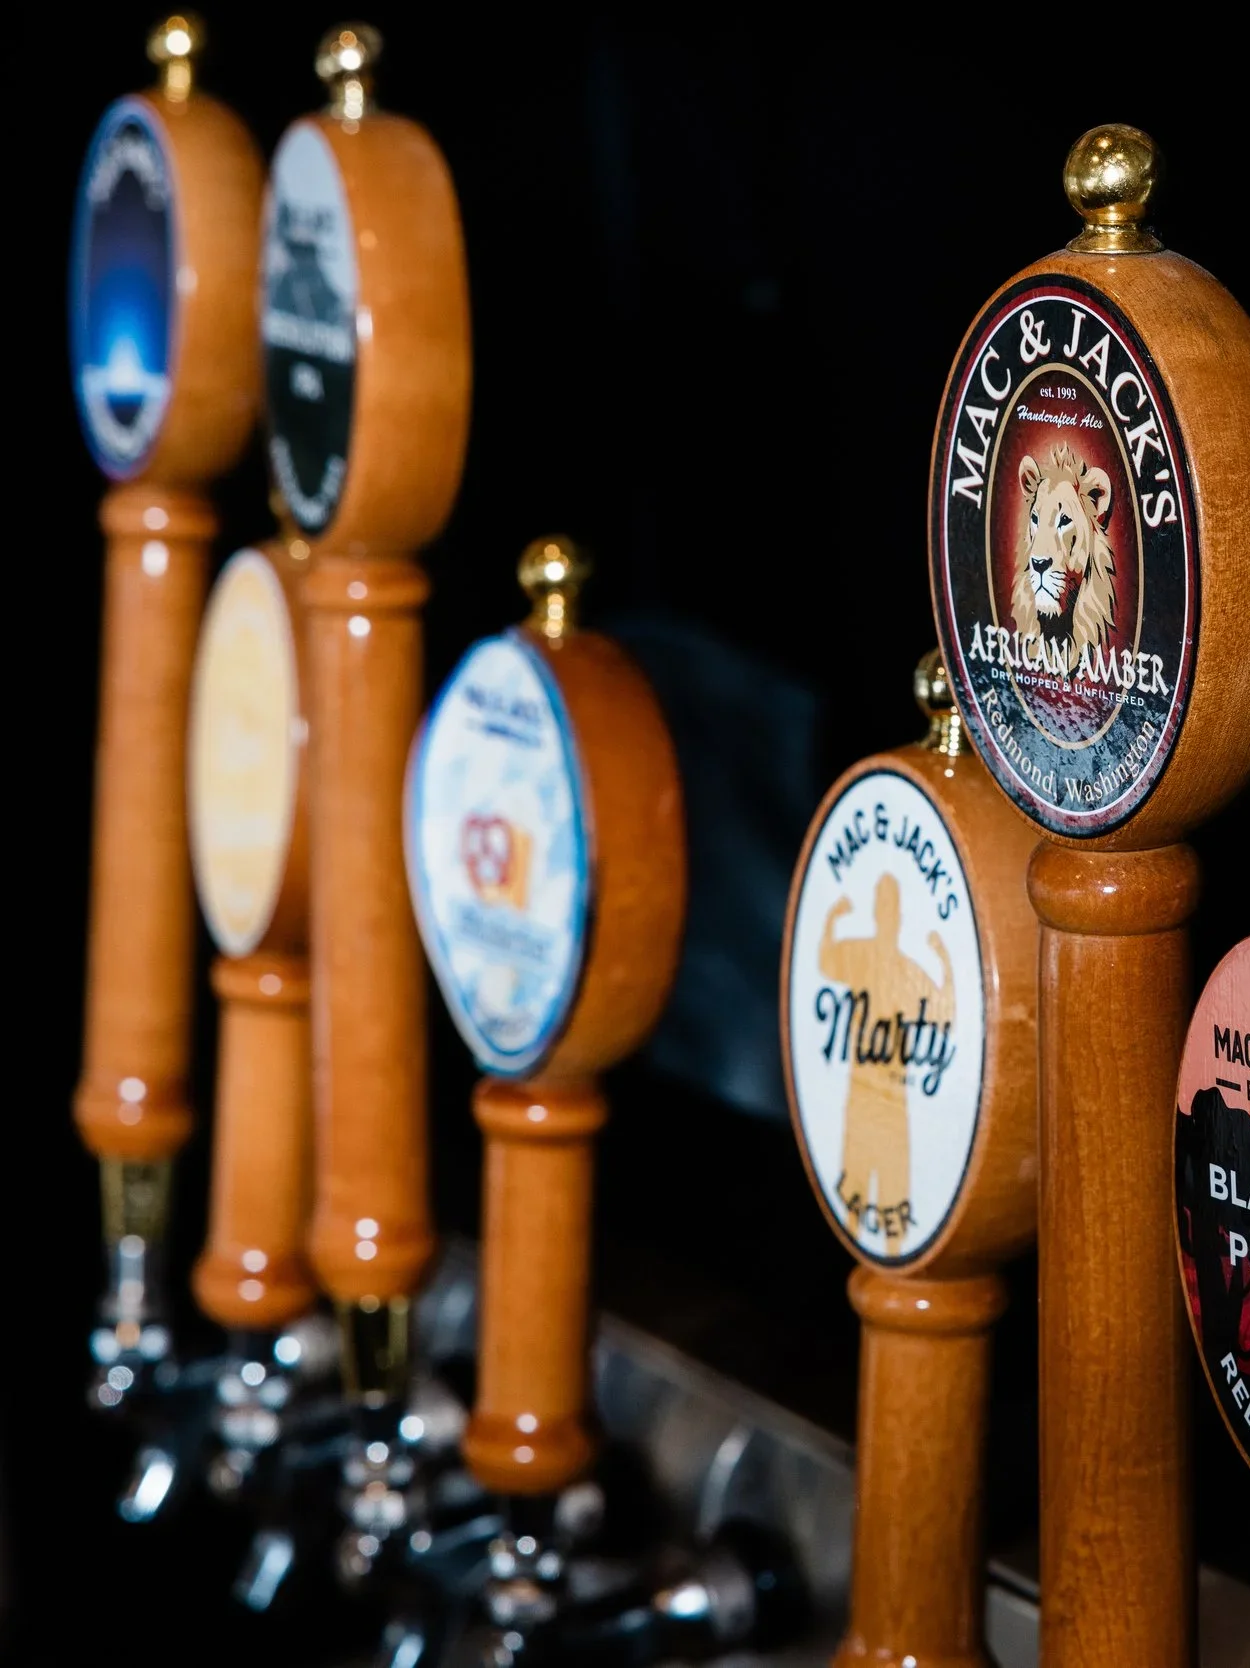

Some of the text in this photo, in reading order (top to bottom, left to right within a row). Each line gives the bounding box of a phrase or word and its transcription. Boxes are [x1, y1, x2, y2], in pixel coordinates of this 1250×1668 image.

[951, 308, 1178, 528] MAC & JACK'S
[1017, 405, 1103, 429] Handcrafted Ales
[1040, 387, 1076, 400] est. 1993
[968, 621, 1170, 696] AFRICAN AMBER
[991, 668, 1145, 706] DRY HOPPED & UNFILTERED
[982, 687, 1156, 804] Redmond, Washington
[828, 802, 958, 920] MAC & JACK'S
[815, 987, 957, 1097] Marty
[835, 1169, 918, 1238] LAGER
